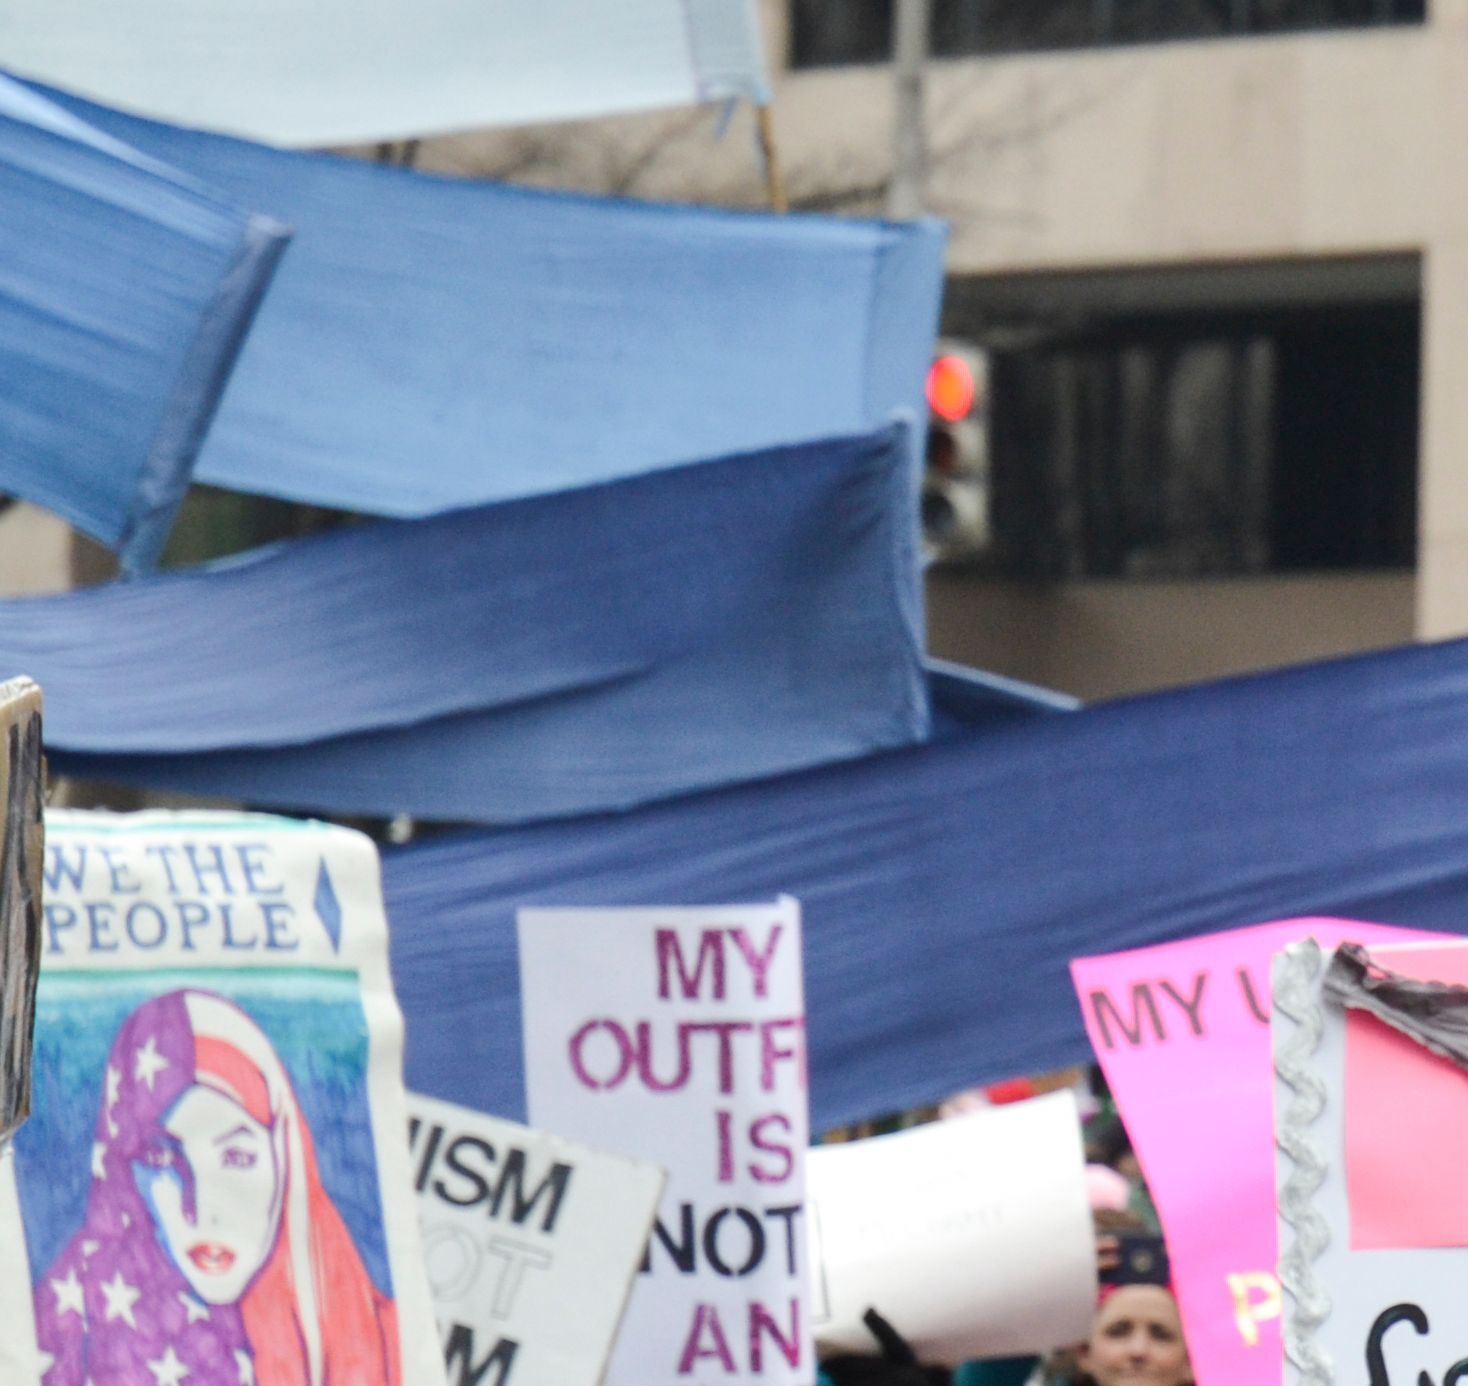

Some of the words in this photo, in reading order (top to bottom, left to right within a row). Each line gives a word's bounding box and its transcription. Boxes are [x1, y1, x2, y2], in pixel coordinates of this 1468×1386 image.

[44, 845, 142, 896] WE
[146, 843, 283, 897] THE
[44, 903, 299, 952] PEOPLE
[656, 922, 781, 999] MY
[1089, 968, 1208, 1049] MY
[569, 1015, 805, 1092] OUTF
[716, 1110, 795, 1182] IS
[639, 1204, 802, 1276] NOT
[678, 1298, 800, 1374] AN
